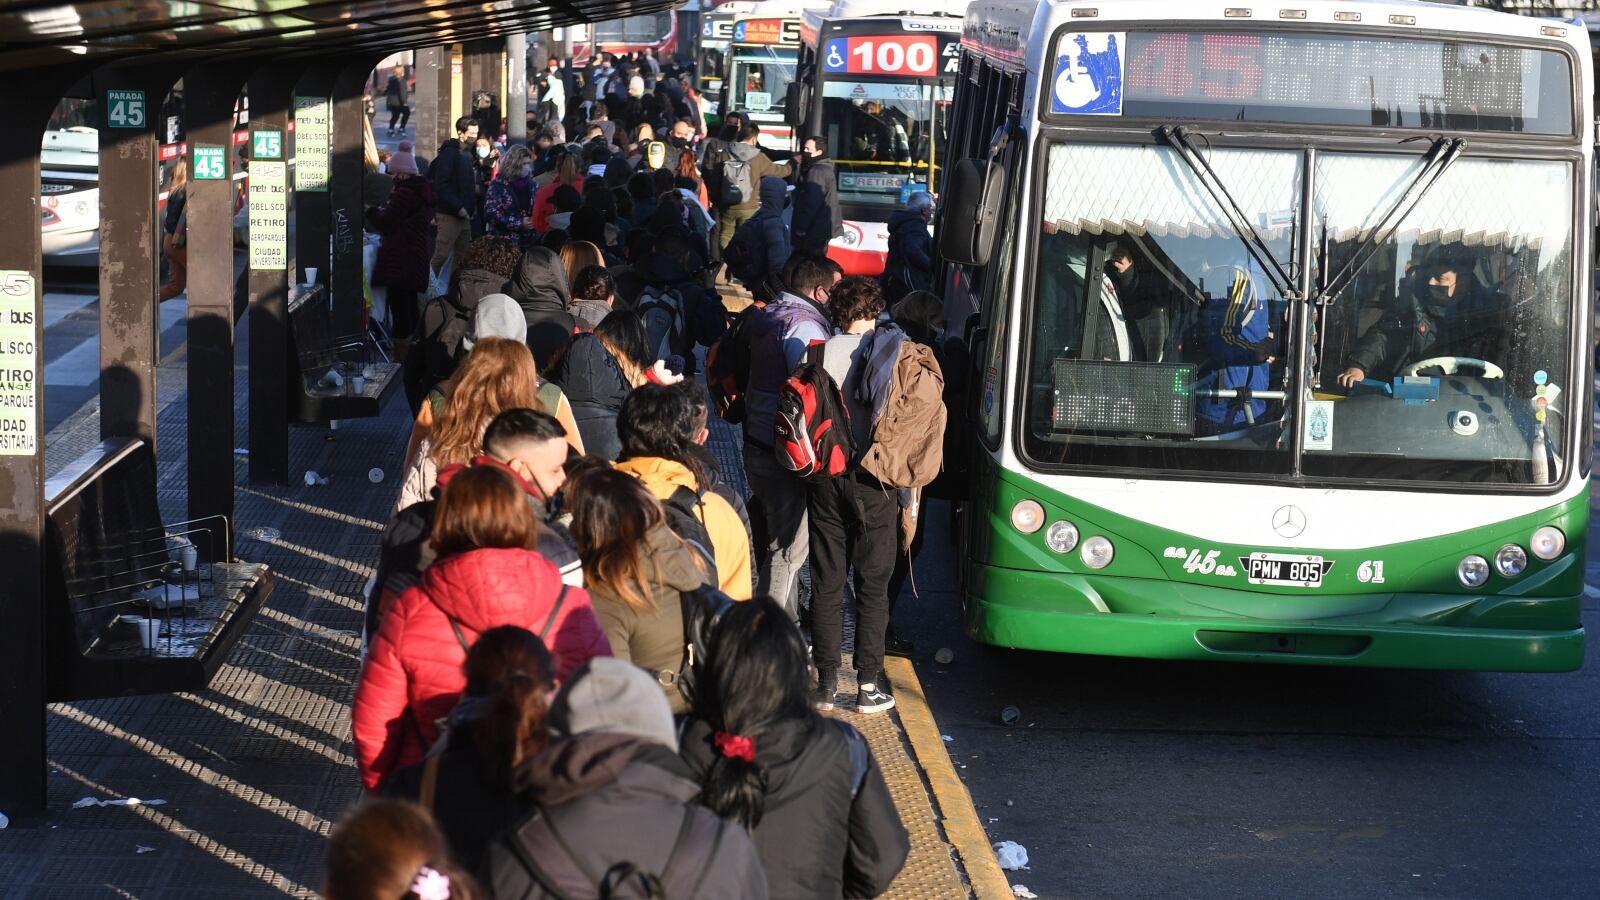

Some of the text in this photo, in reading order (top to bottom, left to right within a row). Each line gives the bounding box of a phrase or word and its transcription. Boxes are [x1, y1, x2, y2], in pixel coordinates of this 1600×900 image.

[853, 42, 934, 72] 100
[1129, 33, 1262, 97] 45
[109, 92, 143, 100] PARADA
[110, 101, 144, 126] 45
[255, 137, 280, 157] 45
[297, 147, 327, 155] RETIRO
[194, 156, 224, 177] 45
[251, 163, 284, 177] 45
[857, 177, 904, 187] RETIRO
[250, 219, 285, 227] RETIRO
[254, 247, 281, 256] CIUDAD
[0, 274, 31, 296] 5
[1182, 548, 1221, 575] 45
[1251, 560, 1320, 582] PMW 805
[1356, 560, 1386, 584] 61
